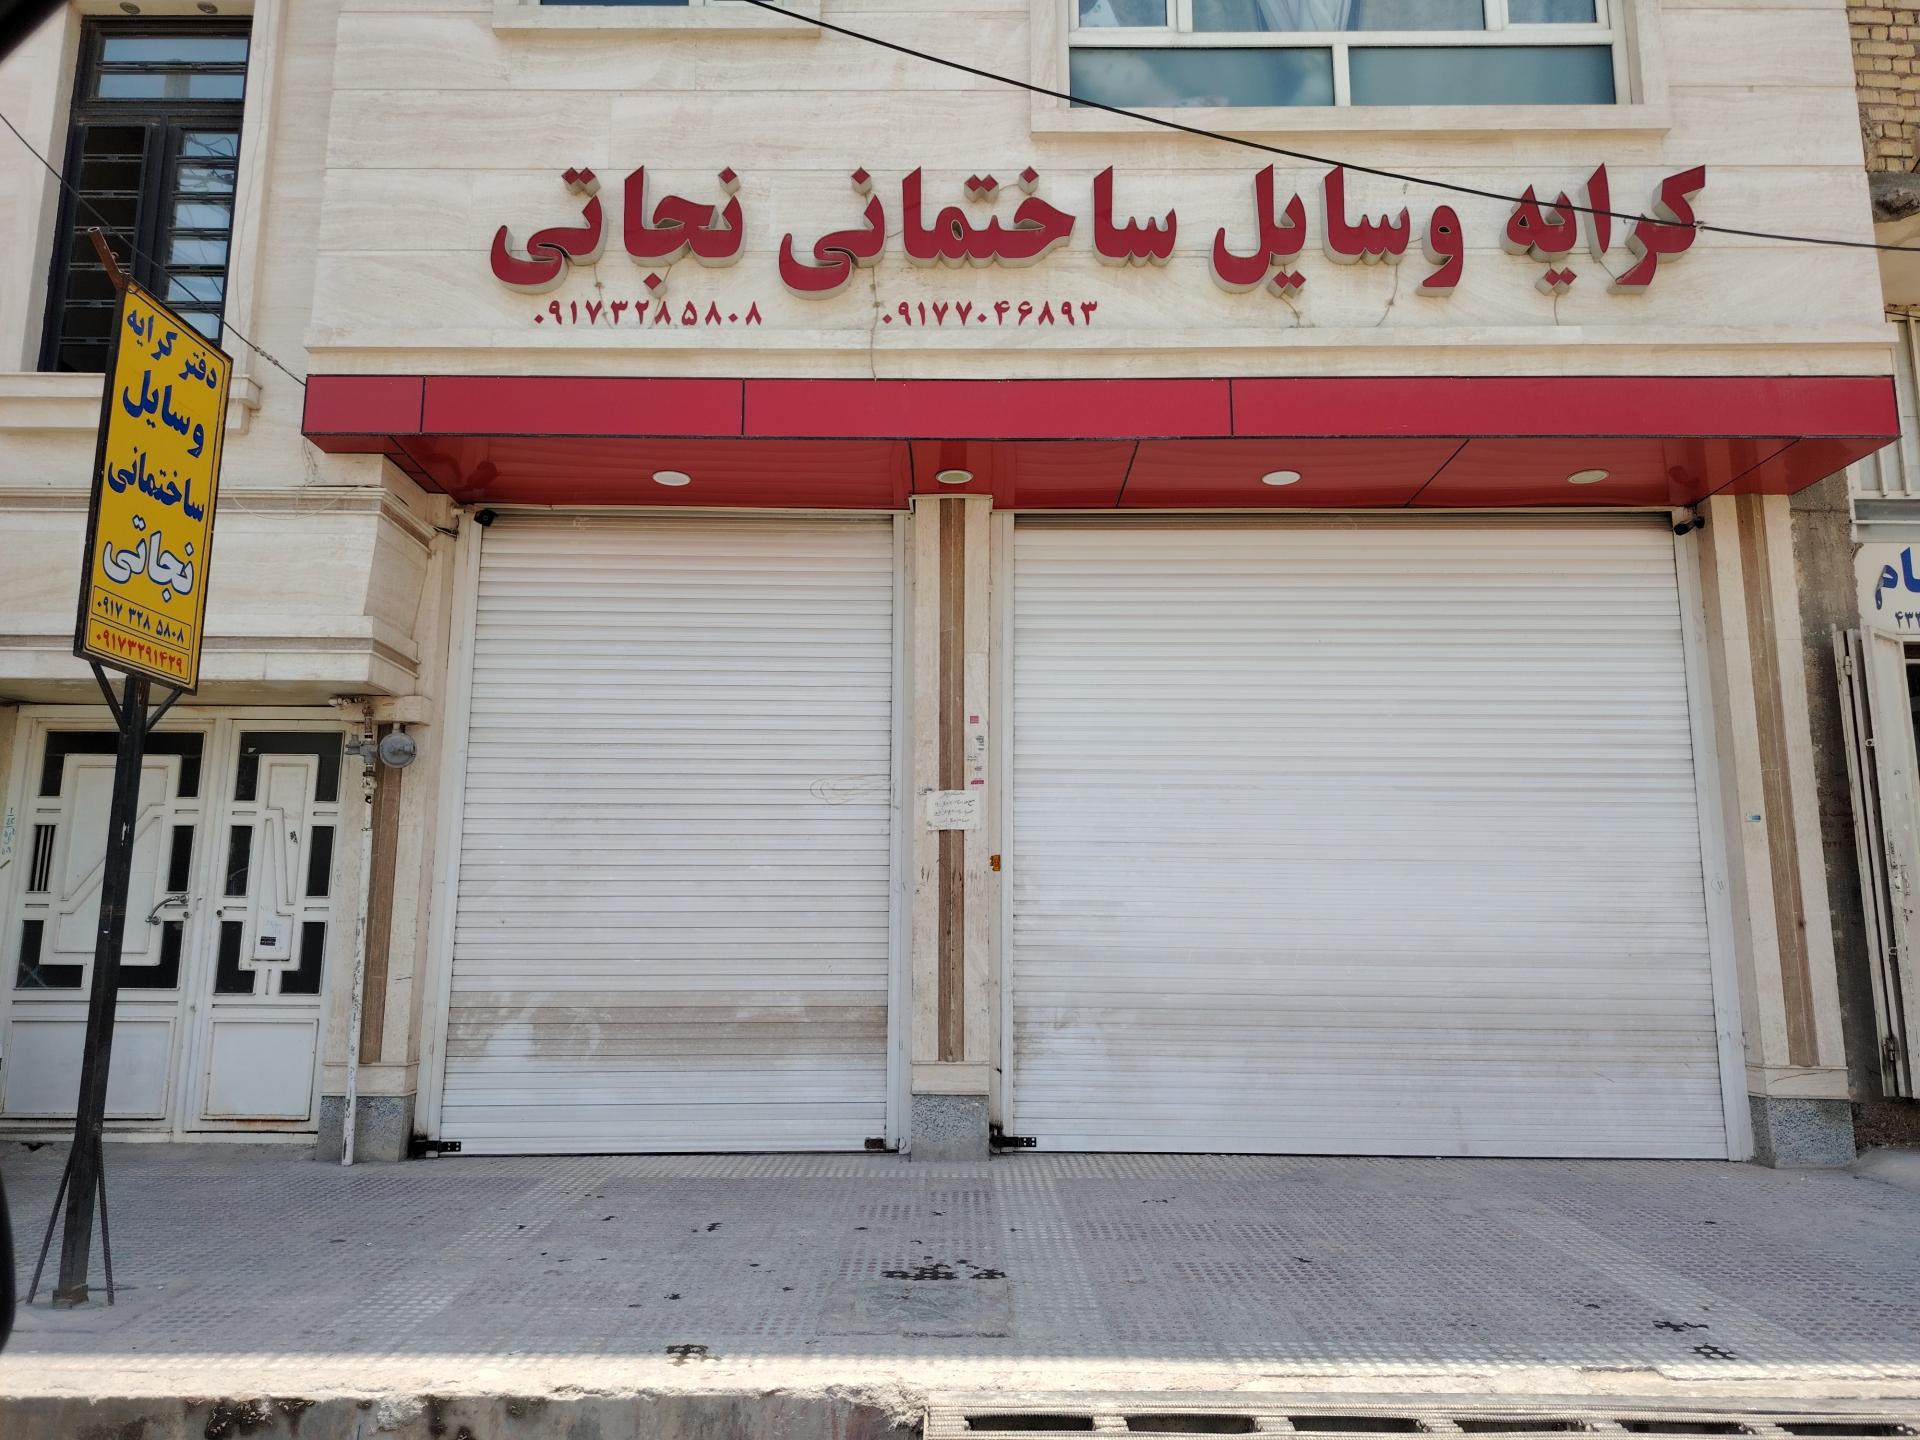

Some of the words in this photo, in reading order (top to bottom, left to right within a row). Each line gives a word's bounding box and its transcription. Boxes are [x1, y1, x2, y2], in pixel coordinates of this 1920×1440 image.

[489, 164, 745, 295] نجاتی
[778, 164, 1177, 296] ساختمانی
[1210, 162, 1464, 294] وسایل
[1504, 162, 1707, 292] کرایه
[126, 309, 179, 360] کرایه
[533, 300, 763, 327] ۰۹۱۷۳۲۸۵۸۰۸
[881, 300, 1098, 327] ۰۹۱۷۷۰۴۶۸۹۳
[122, 369, 205, 459] وسایل
[178, 351, 218, 390] دفتر
[107, 446, 205, 522] ساختمانی
[102, 514, 195, 603] نجاتی
